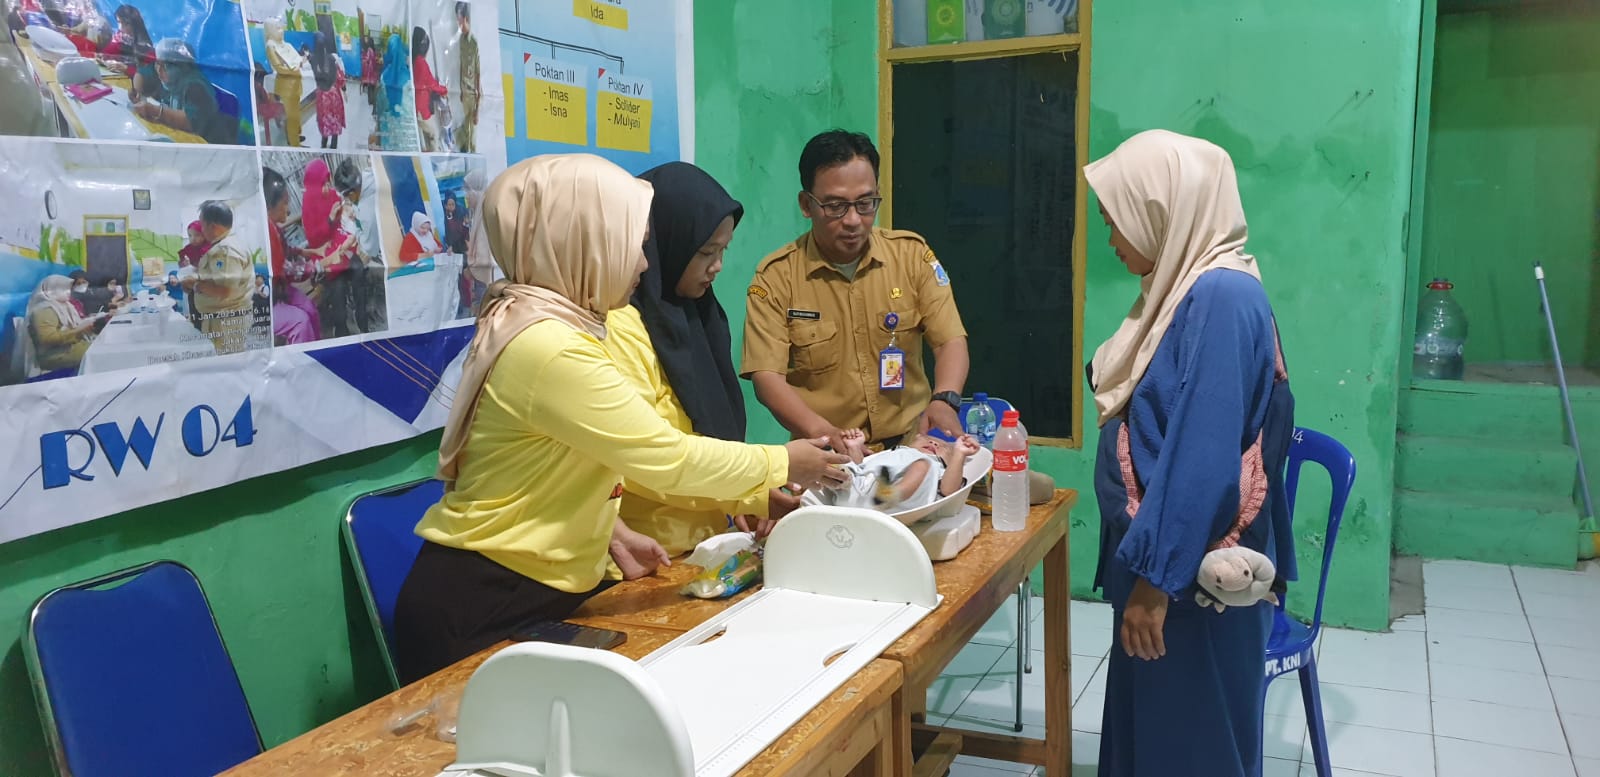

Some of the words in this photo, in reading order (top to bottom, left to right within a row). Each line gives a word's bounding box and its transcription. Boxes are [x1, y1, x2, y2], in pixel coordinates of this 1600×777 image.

[591, 4, 604, 20] Ida
[535, 62, 564, 81] Poktan
[566, 69, 575, 84] III
[549, 85, 569, 102] Imas
[633, 82, 644, 96] IV
[550, 102, 568, 118] Isna
[199, 312, 213, 321] Jan
[40, 412, 165, 489] RW
[182, 394, 257, 457] 04
[1283, 652, 1300, 671] KNI
